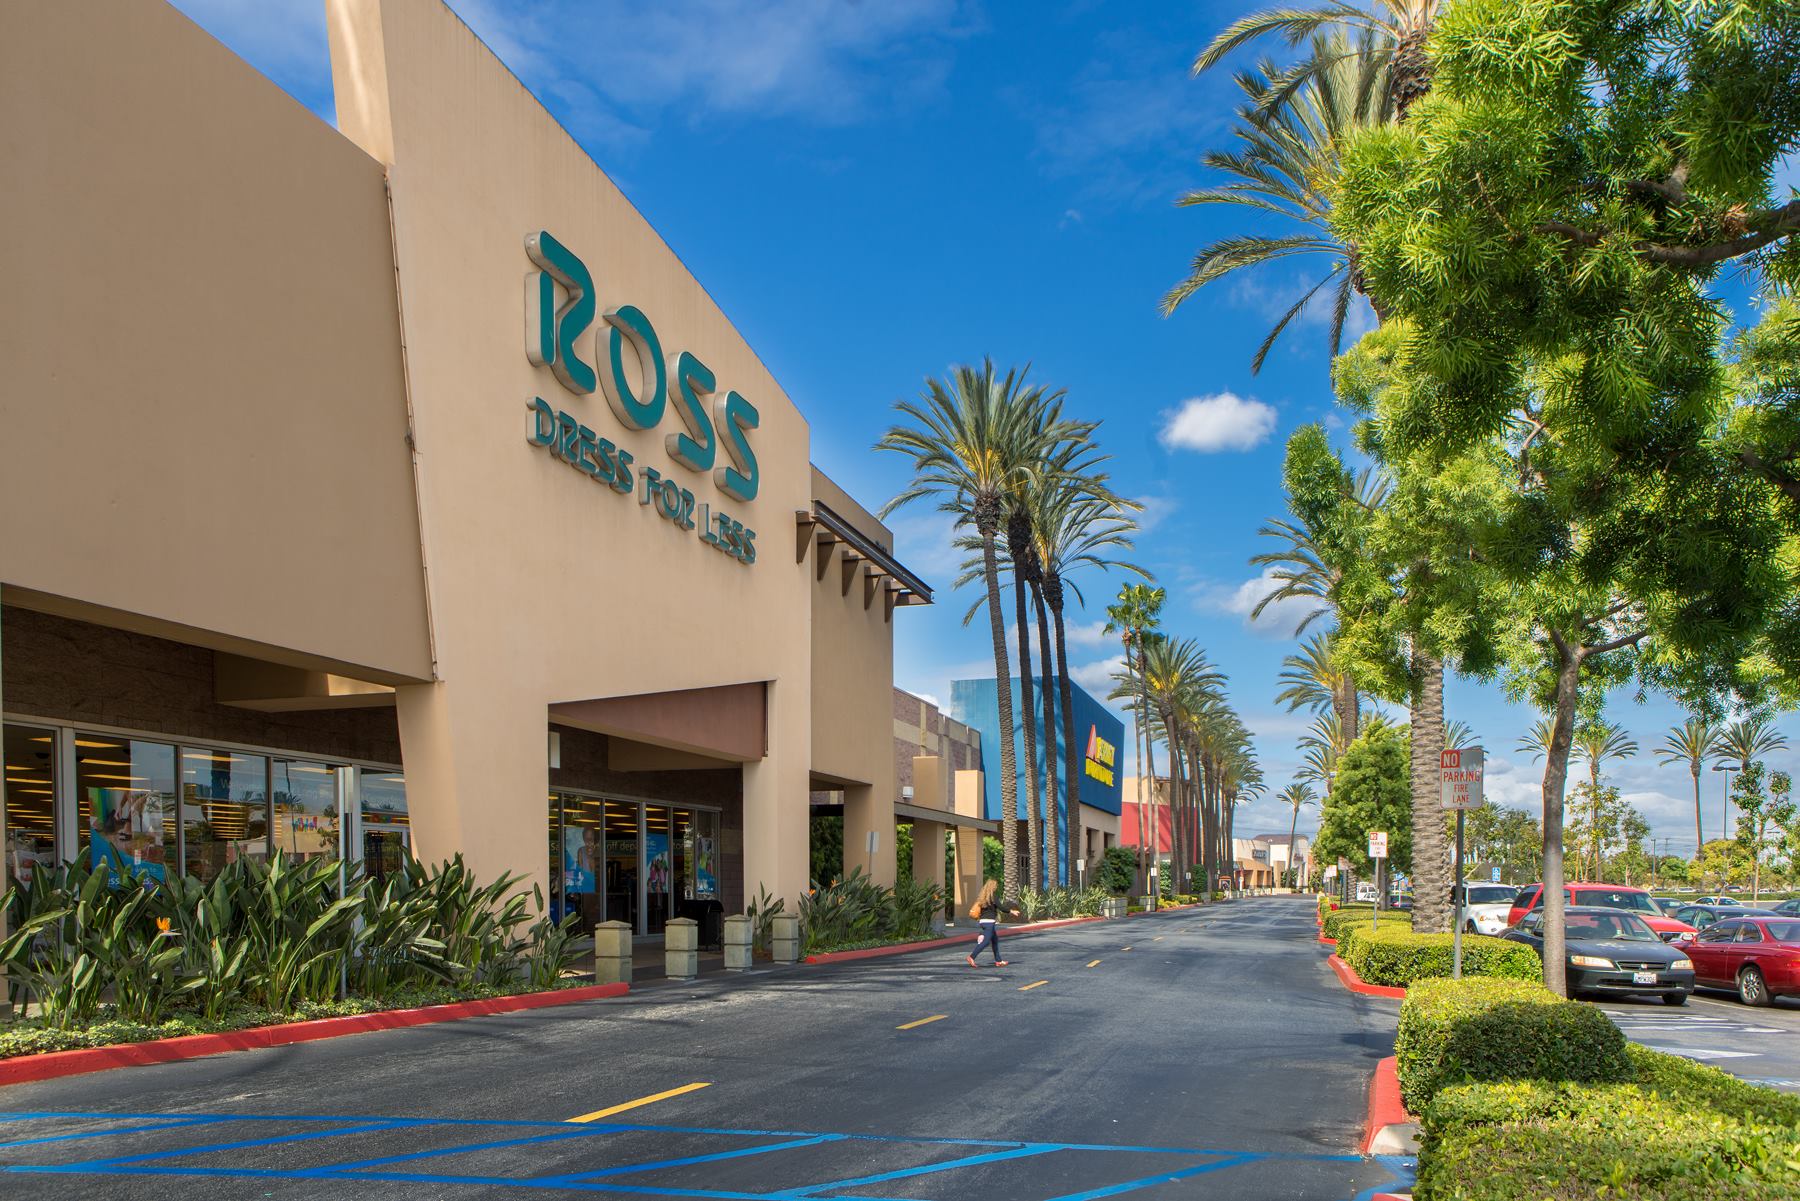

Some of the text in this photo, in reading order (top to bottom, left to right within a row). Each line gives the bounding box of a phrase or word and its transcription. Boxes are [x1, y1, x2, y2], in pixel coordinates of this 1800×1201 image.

[524, 230, 760, 502] ROSS
[526, 396, 757, 565] DRESS FOR LESS
[1443, 753, 1458, 767] NO
[1443, 771, 1480, 782] PARKING
[1454, 783, 1469, 793] FIRE
[1452, 794, 1469, 803] LANE
